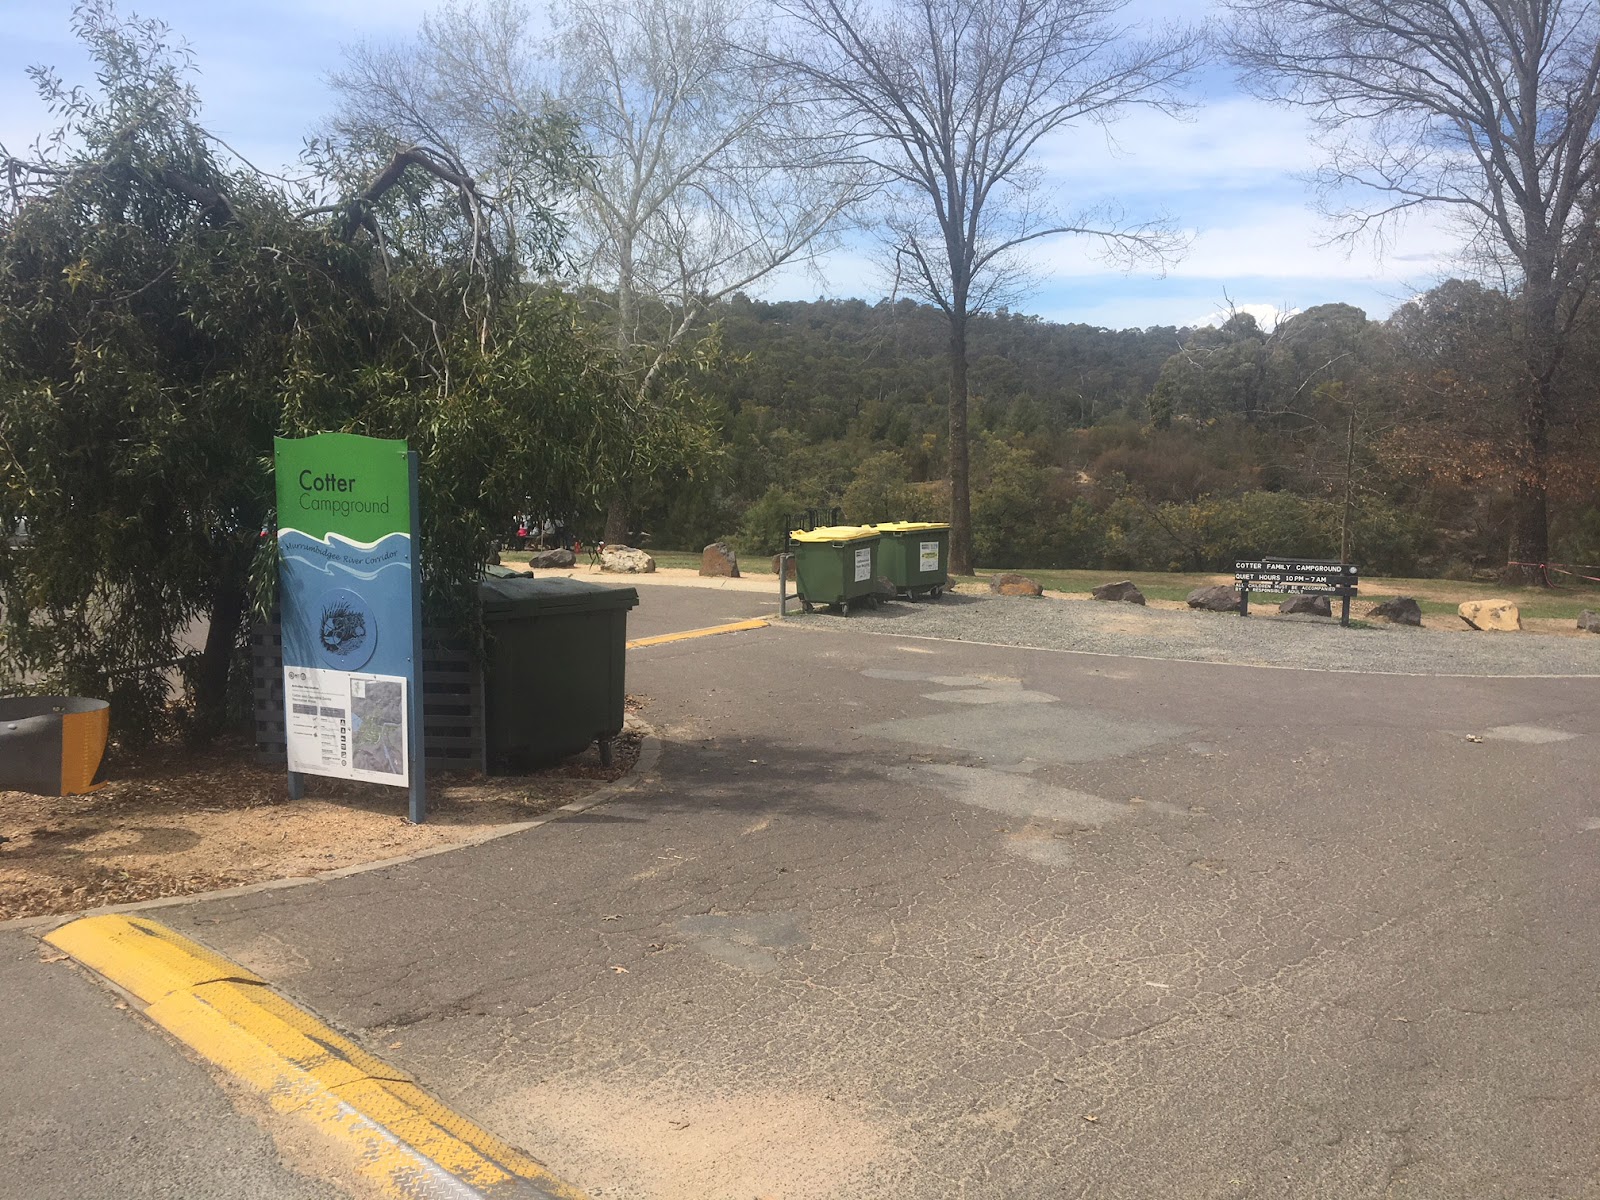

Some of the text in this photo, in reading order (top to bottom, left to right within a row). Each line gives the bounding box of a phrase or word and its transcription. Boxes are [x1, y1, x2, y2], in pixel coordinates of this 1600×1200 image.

[299, 469, 356, 492] Cotter
[299, 493, 389, 517] Campground
[285, 541, 398, 565] Murrumbidgee River Corridor
